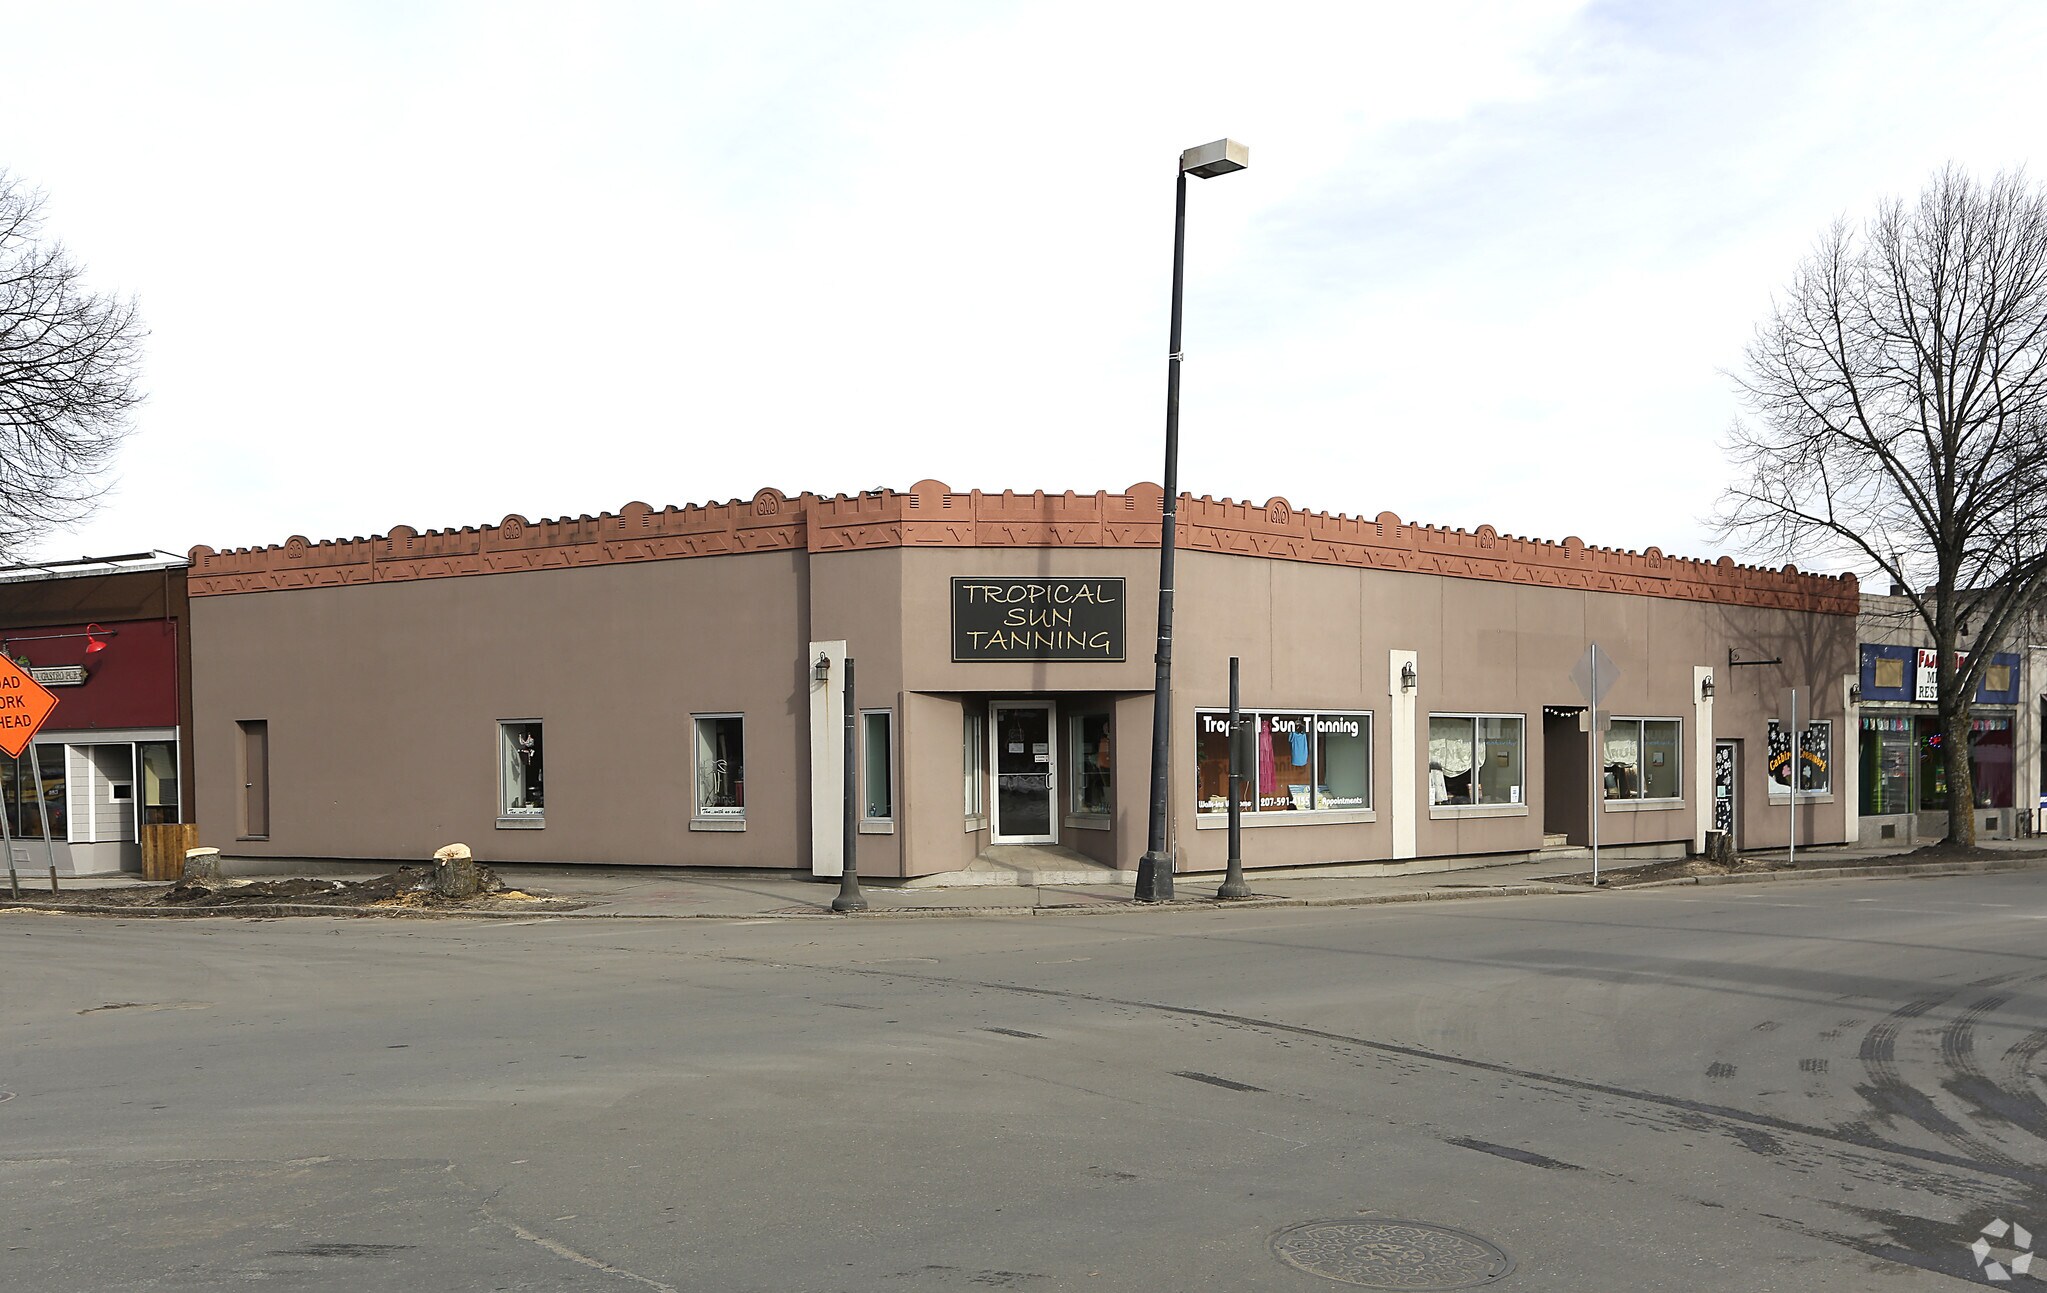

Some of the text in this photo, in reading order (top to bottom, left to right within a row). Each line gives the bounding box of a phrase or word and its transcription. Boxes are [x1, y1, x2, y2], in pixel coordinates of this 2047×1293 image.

[962, 583, 1116, 604] TROPICAL
[1003, 608, 1073, 627] SUN
[966, 629, 1110, 655] TANNING
[0, 676, 20, 690] AD
[0, 695, 26, 709] ORK
[0, 714, 32, 729] HEAD
[1271, 716, 1295, 732] Sun
[1303, 716, 1359, 737] Tanning
[1769, 751, 1792, 771] Catbir
[1322, 796, 1362, 806] Appointments
